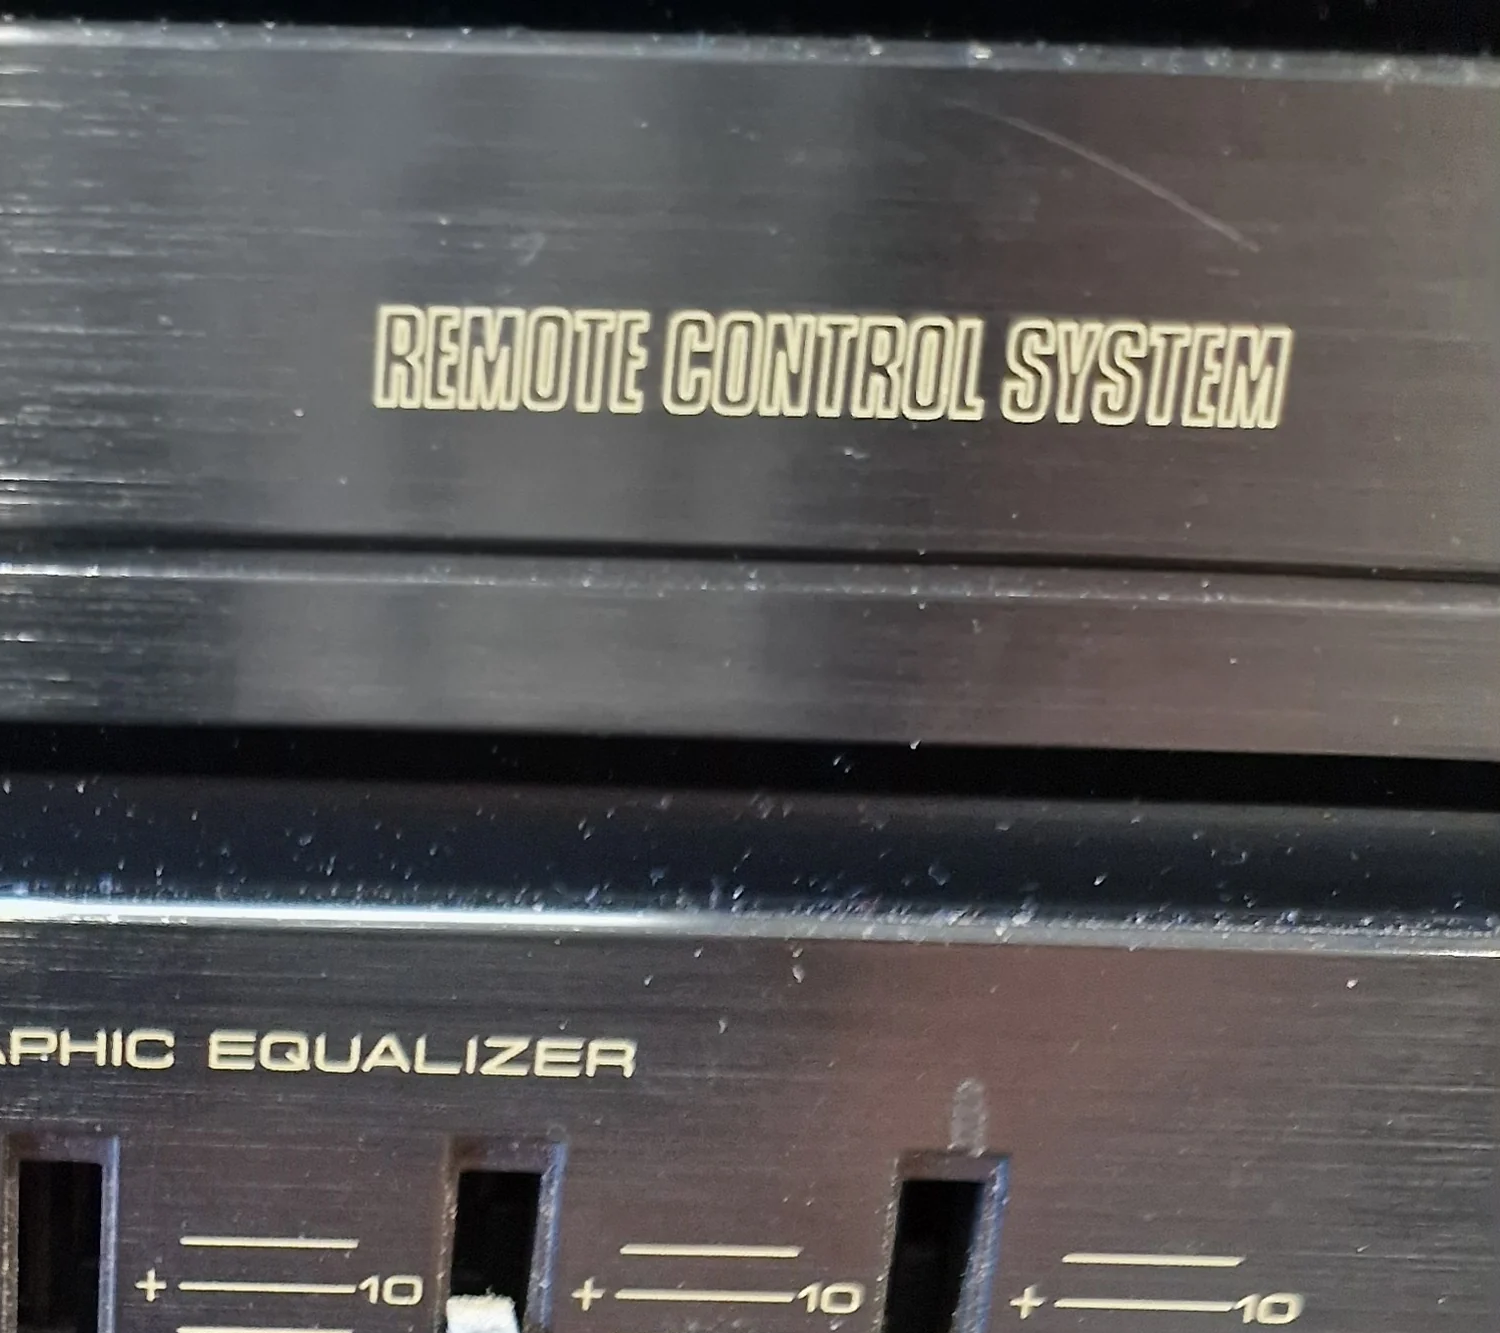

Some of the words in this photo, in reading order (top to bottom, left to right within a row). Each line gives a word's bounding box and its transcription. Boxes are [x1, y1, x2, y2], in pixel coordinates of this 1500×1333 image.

[373, 304, 651, 414] REMOTE
[661, 309, 985, 421] CONTROL
[1000, 318, 1294, 429] SYSTEM
[208, 1030, 637, 1078] EQUALIZER
[358, 1275, 423, 1306] 10
[796, 1282, 863, 1314] 10
[1234, 1292, 1303, 1325] 10
